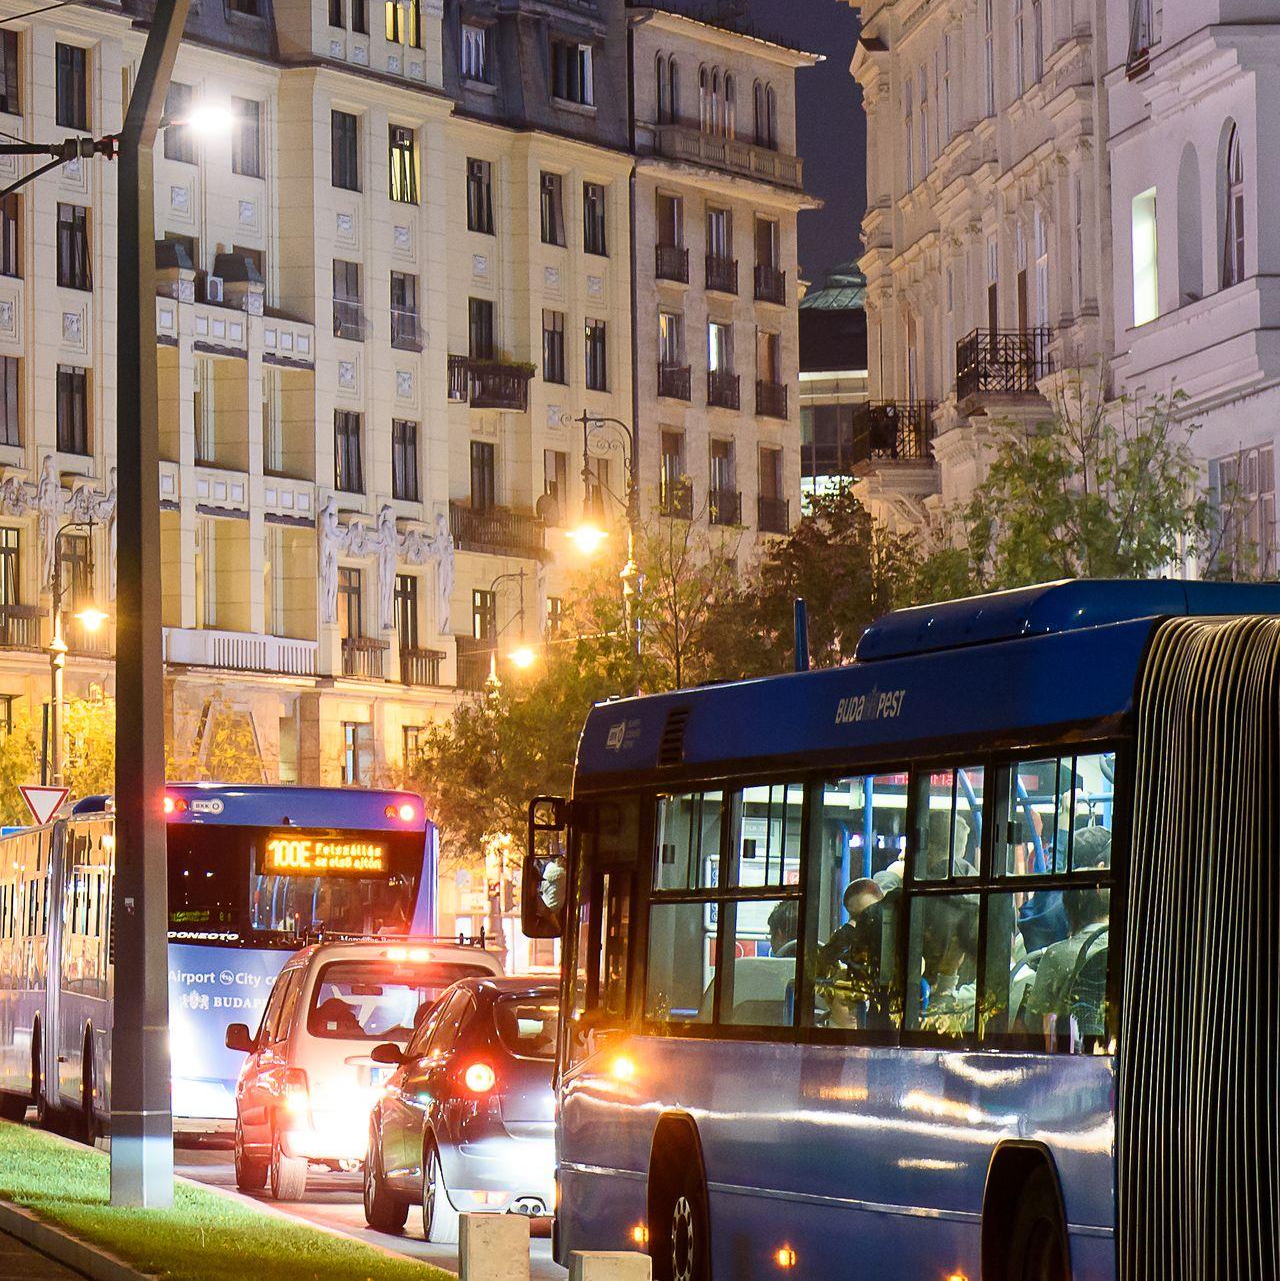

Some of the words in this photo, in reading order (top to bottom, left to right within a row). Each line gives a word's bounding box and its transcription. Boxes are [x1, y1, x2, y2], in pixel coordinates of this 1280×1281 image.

[268, 839, 312, 868] 100E
[168, 970, 216, 985] Airport
[236, 972, 261, 988] City
[213, 997, 268, 1008] BUDAP
